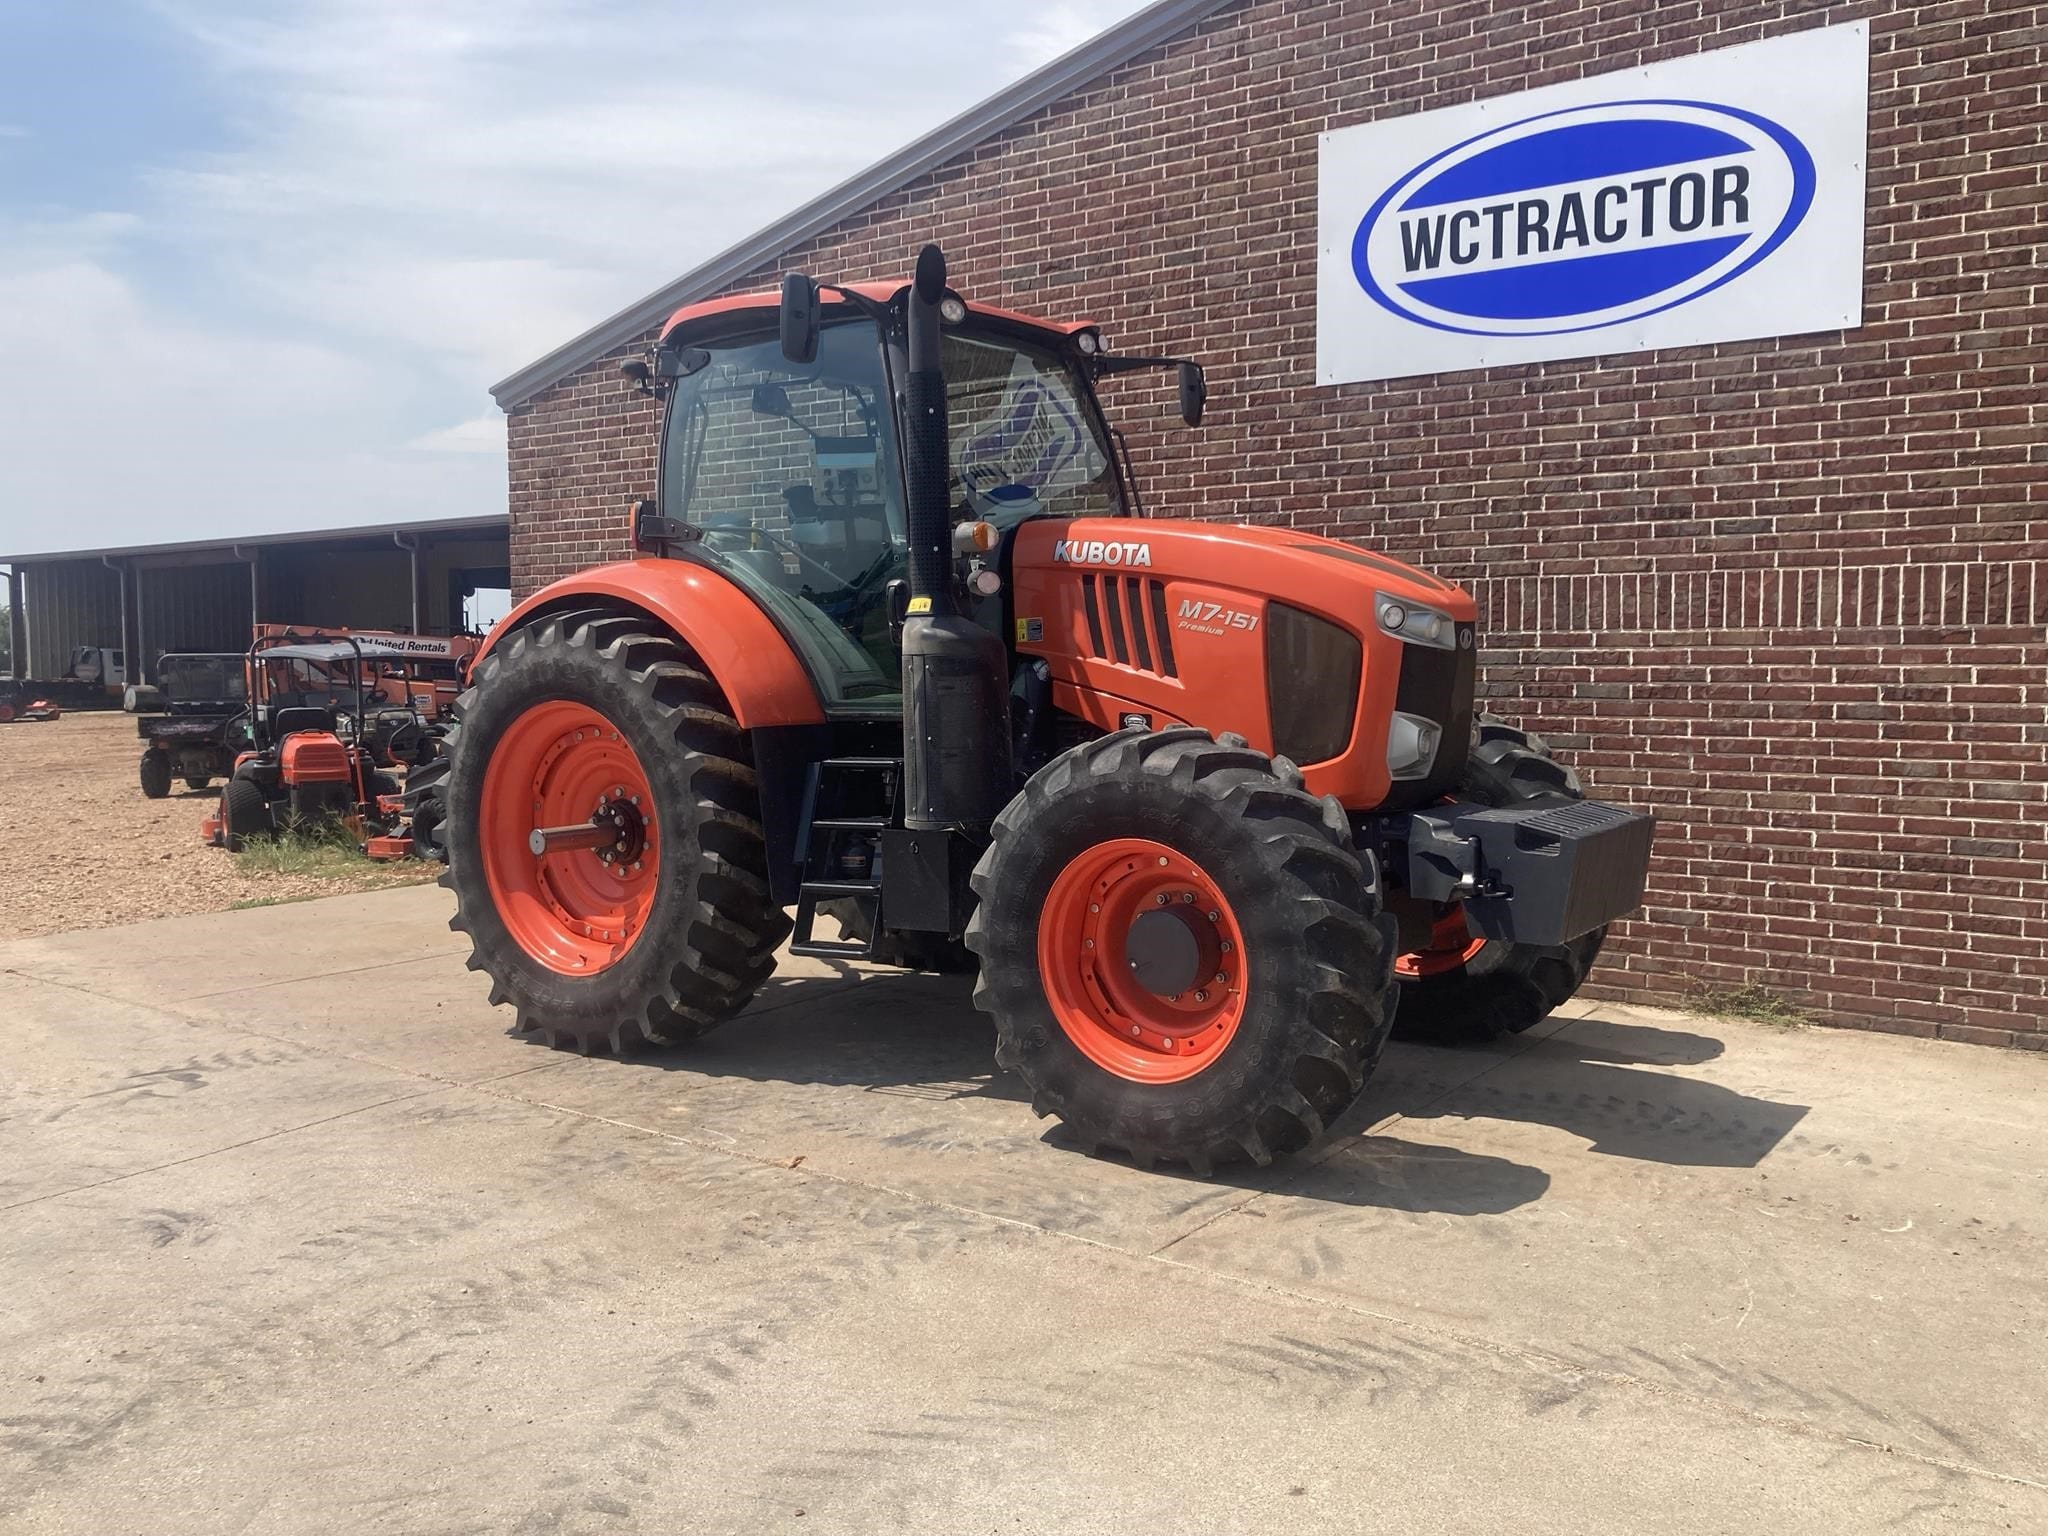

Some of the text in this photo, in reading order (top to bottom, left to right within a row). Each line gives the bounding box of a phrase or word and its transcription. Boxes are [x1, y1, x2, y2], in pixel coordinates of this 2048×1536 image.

[1400, 165, 1750, 272] WCTRACTOR
[1053, 540, 1152, 567] KUBOTA
[1178, 599, 1259, 632] M7-151
[1178, 620, 1225, 636] Premium
[407, 641, 446, 653] Rentals
